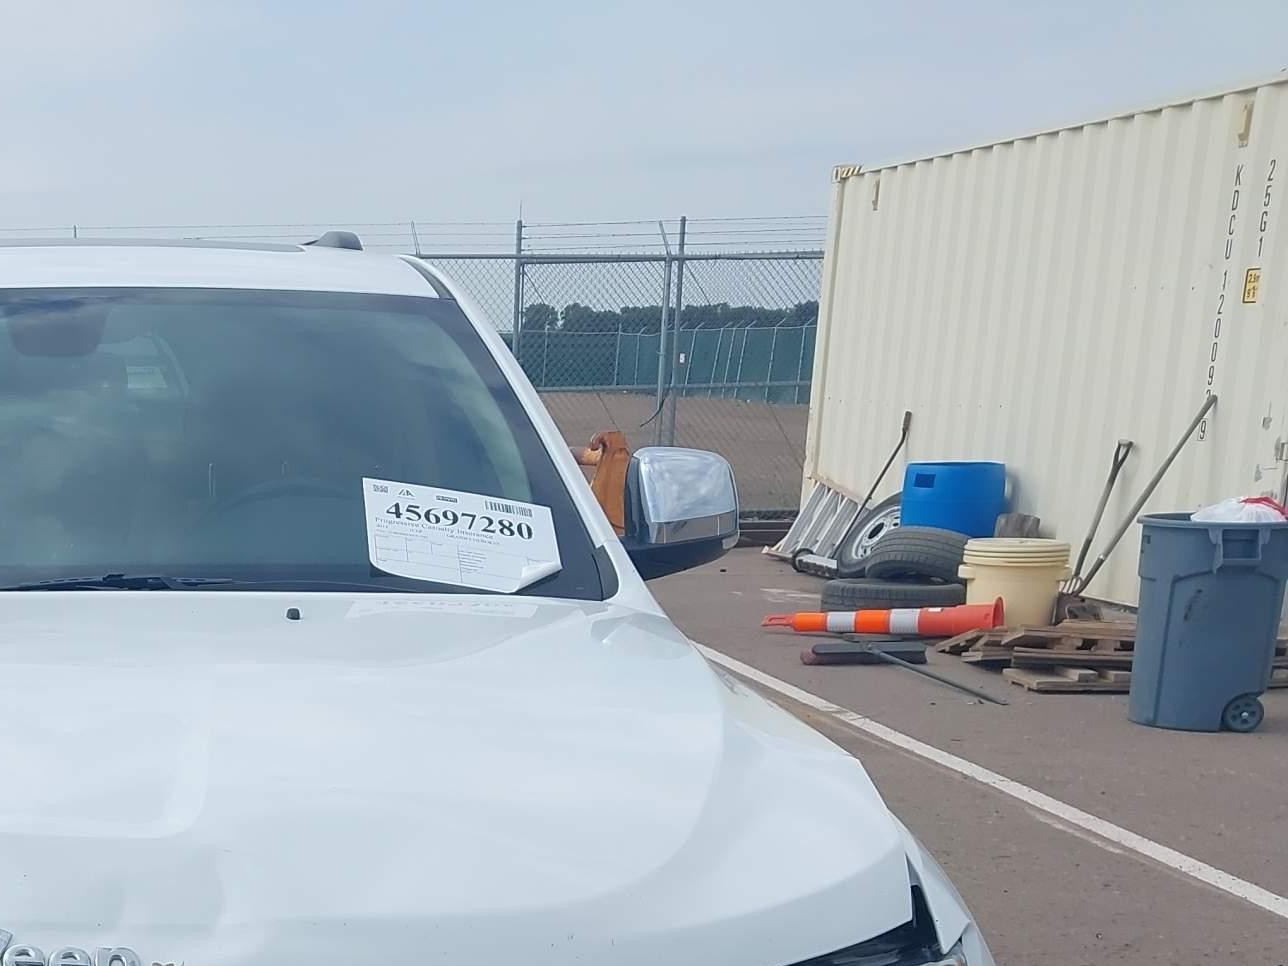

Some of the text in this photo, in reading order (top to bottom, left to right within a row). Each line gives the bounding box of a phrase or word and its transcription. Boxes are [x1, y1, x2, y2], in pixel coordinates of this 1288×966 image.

[1225, 164, 1243, 260] KDCU
[1258, 159, 1276, 257] 25G1
[386, 502, 533, 540] 45697280
